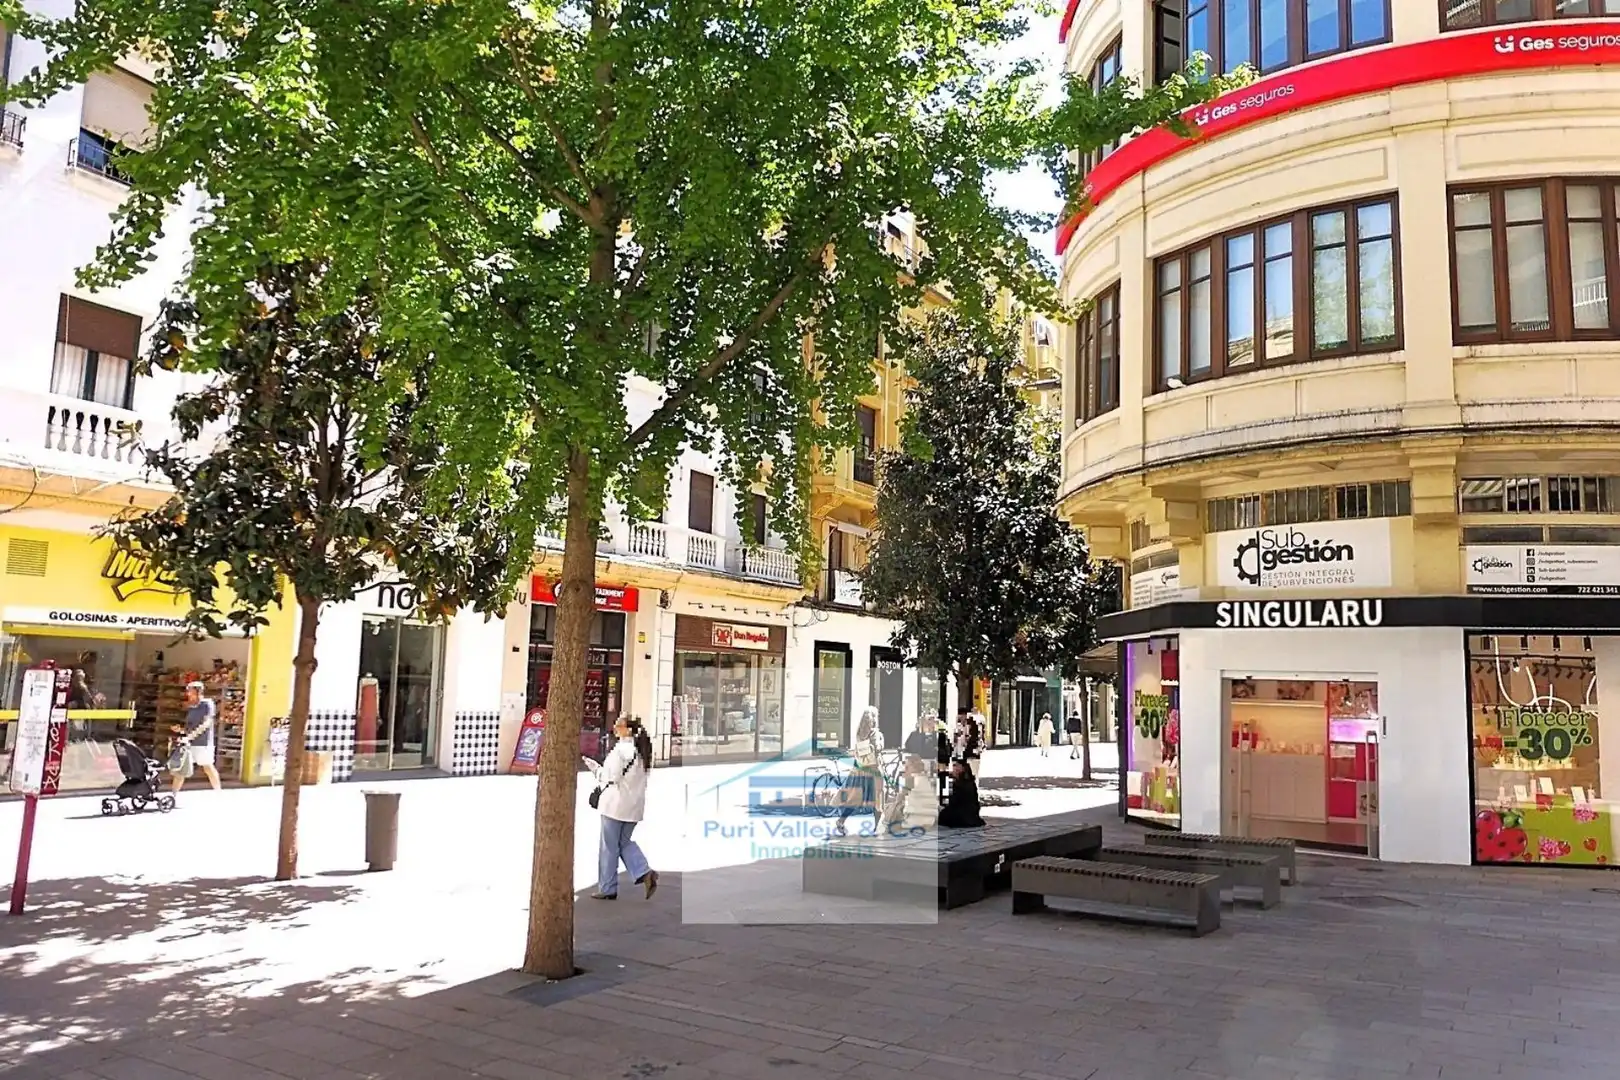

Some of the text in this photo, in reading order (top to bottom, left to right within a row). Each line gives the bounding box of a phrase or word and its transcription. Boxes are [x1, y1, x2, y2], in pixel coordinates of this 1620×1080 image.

[1519, 35, 1620, 51] Ges seguros
[1212, 84, 1295, 120] Ges seguros
[1261, 526, 1306, 550] Sub
[1261, 539, 1354, 571] gestión
[1262, 568, 1356, 580] GESTIÓN INTEGRAL
[1277, 575, 1356, 587] SUBVENCIONES
[595, 588, 625, 598] TAINMENT
[1472, 586, 1619, 594] www.subgestion.com 722 421 341
[49, 611, 187, 628] GOLOSINAS APERITIVOS
[1215, 599, 1383, 627] SINGULARU
[877, 660, 901, 670] BOSTON
[1501, 706, 1590, 727] Florecer
